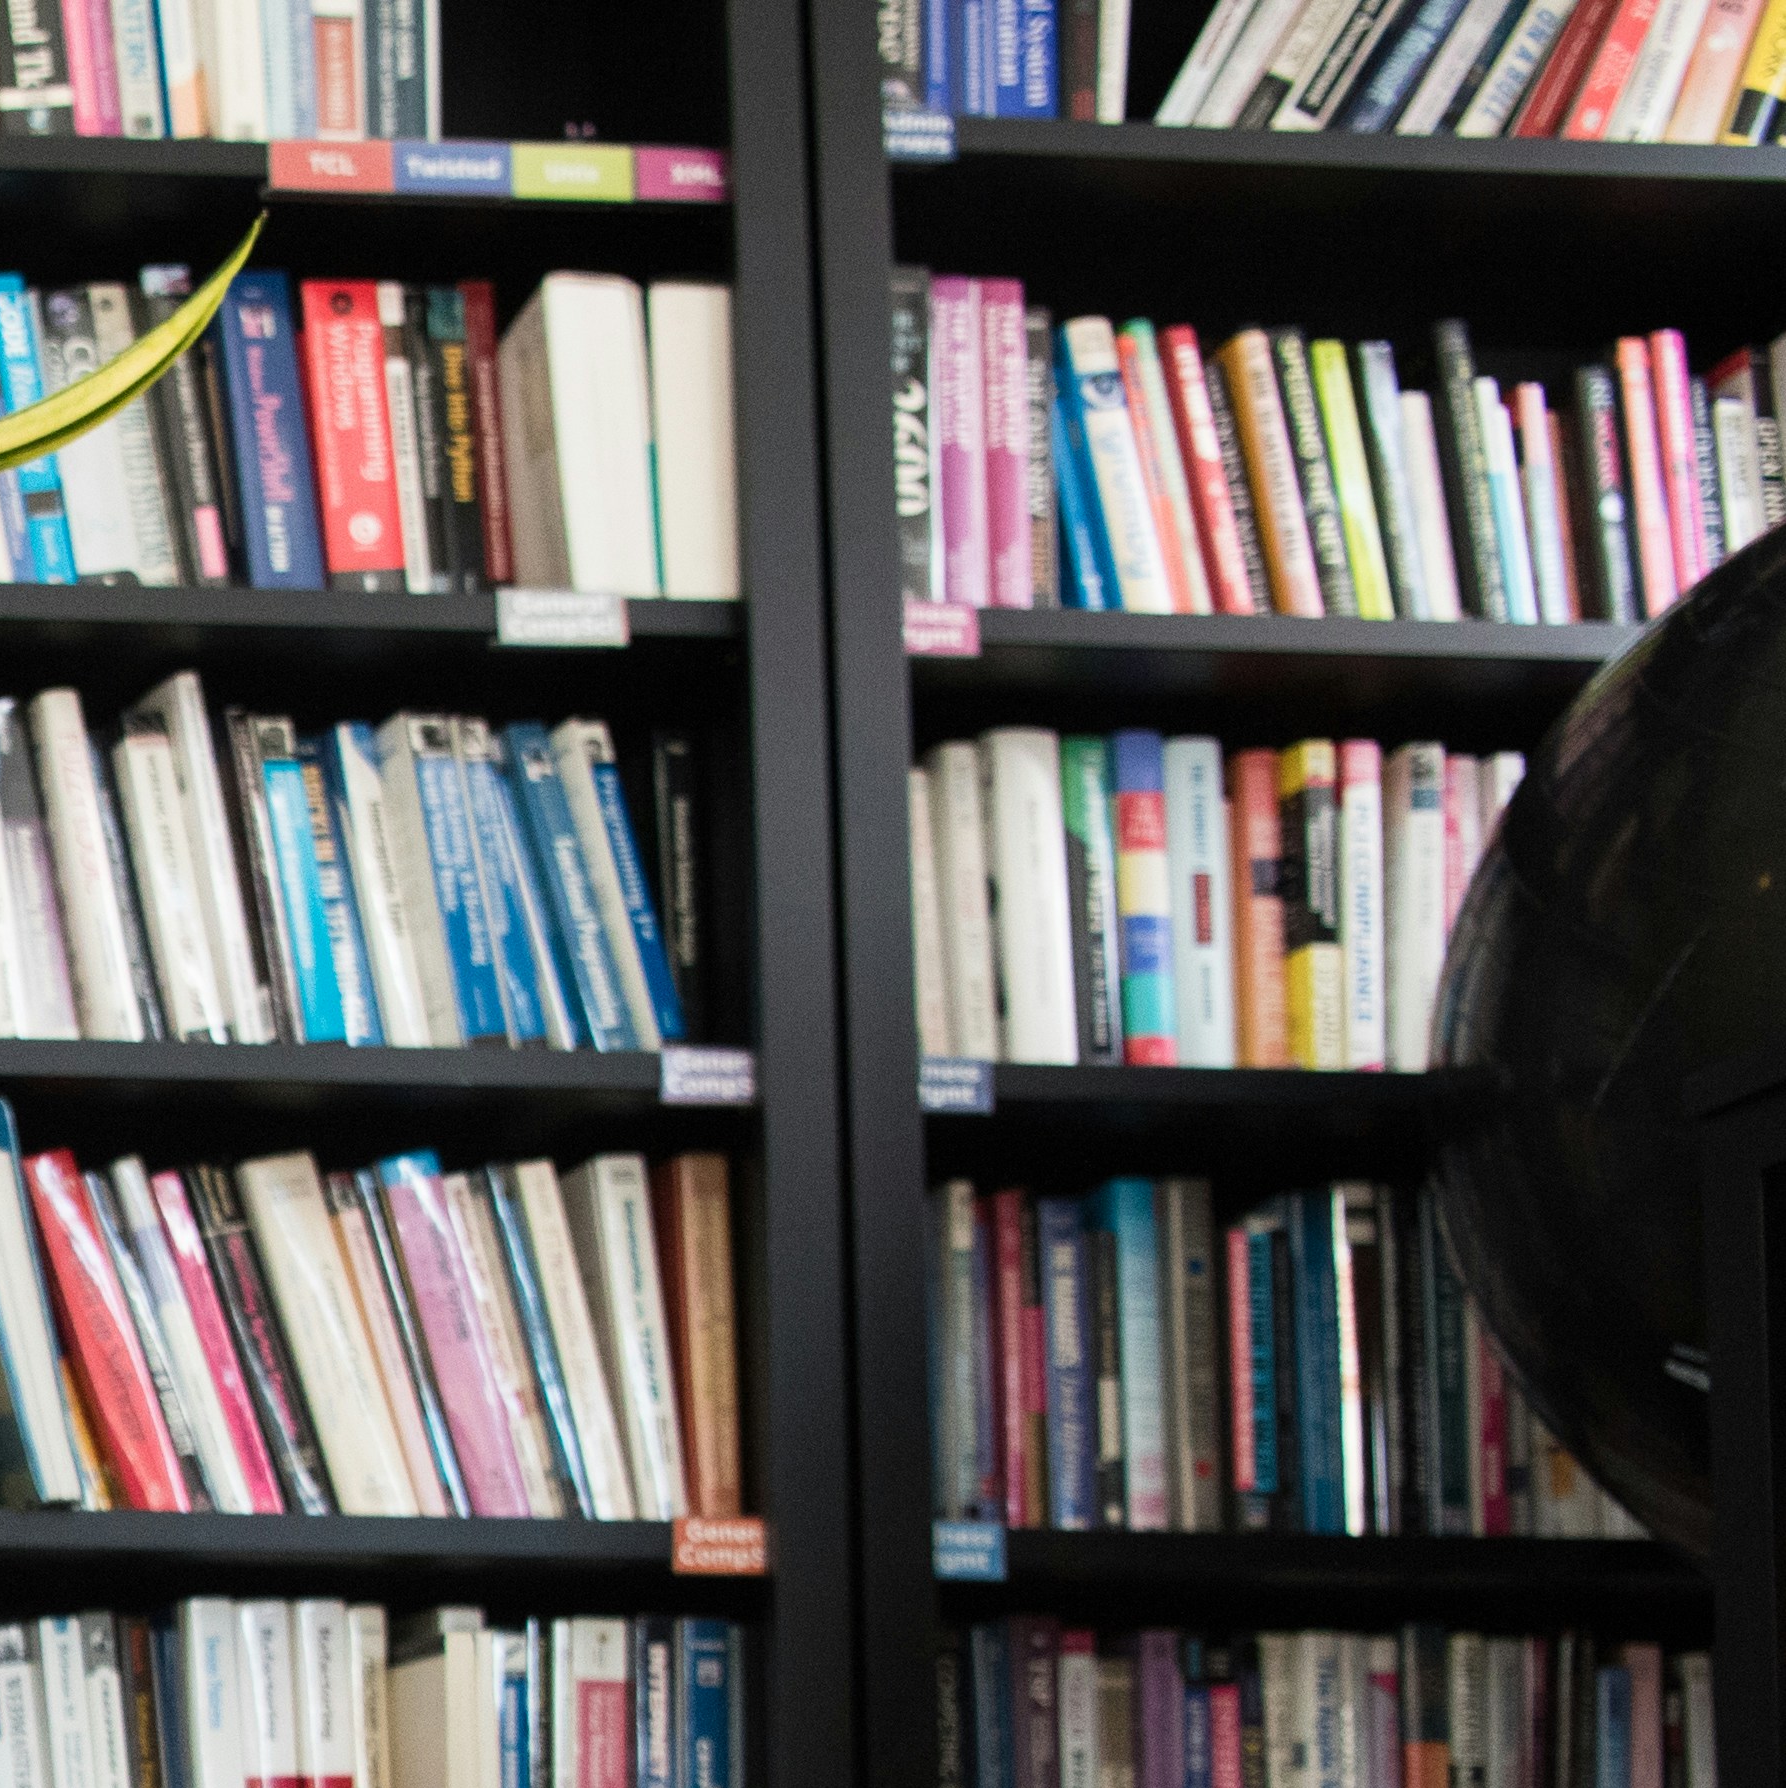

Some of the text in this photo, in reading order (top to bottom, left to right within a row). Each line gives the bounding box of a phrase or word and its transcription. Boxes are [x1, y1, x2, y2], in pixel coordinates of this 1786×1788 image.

[309, 150, 357, 177] TCL
[405, 154, 502, 182] Twisted
[327, 322, 356, 431] Windows
[348, 321, 390, 482] Programming
[255, 395, 293, 502] PowerShell
[448, 434, 475, 502] Python
[602, 773, 647, 913] Programming
[647, 1643, 669, 1781] INTERNET
